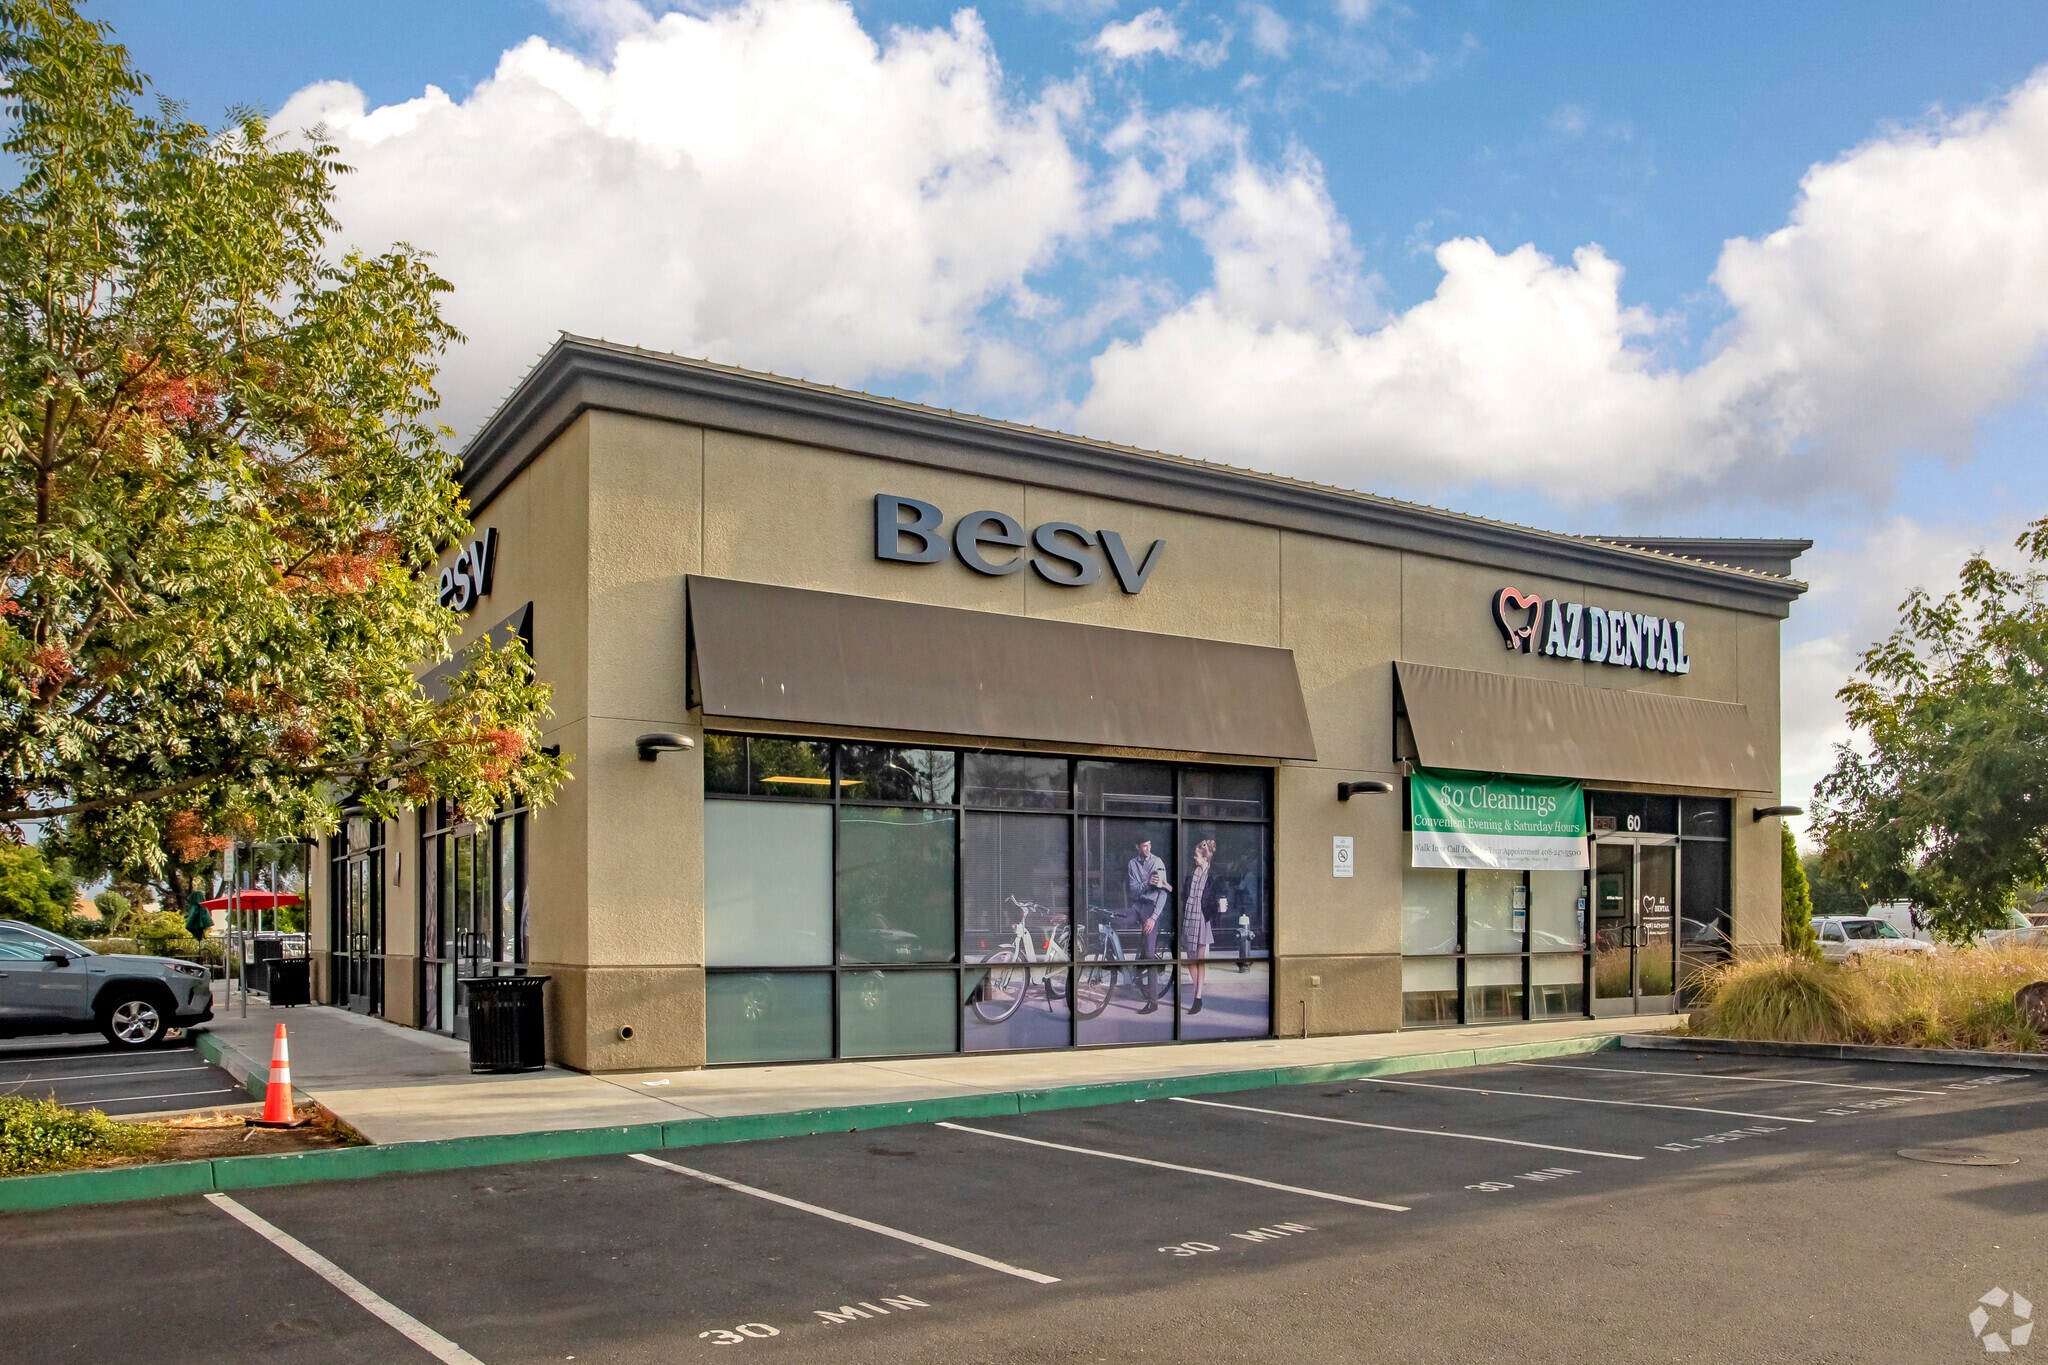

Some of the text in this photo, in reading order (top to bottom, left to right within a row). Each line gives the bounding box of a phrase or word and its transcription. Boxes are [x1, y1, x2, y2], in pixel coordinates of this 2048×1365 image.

[1541, 598, 1690, 675] AZ DENTAL
[1441, 783, 1556, 817] $0 Cleanings
[1414, 814, 1580, 834] Convenient Evening & Saturday Hours
[1593, 817, 1615, 830] PEN
[1627, 814, 1641, 831] 60
[1414, 844, 1430, 853] Walk
[1447, 845, 1460, 854] Call
[1503, 848, 1540, 858] Appointment
[1464, 1167, 1582, 1193] 30 MIN
[1158, 1222, 1319, 1257] 30 MIN
[699, 1294, 931, 1345] 30 MIN
